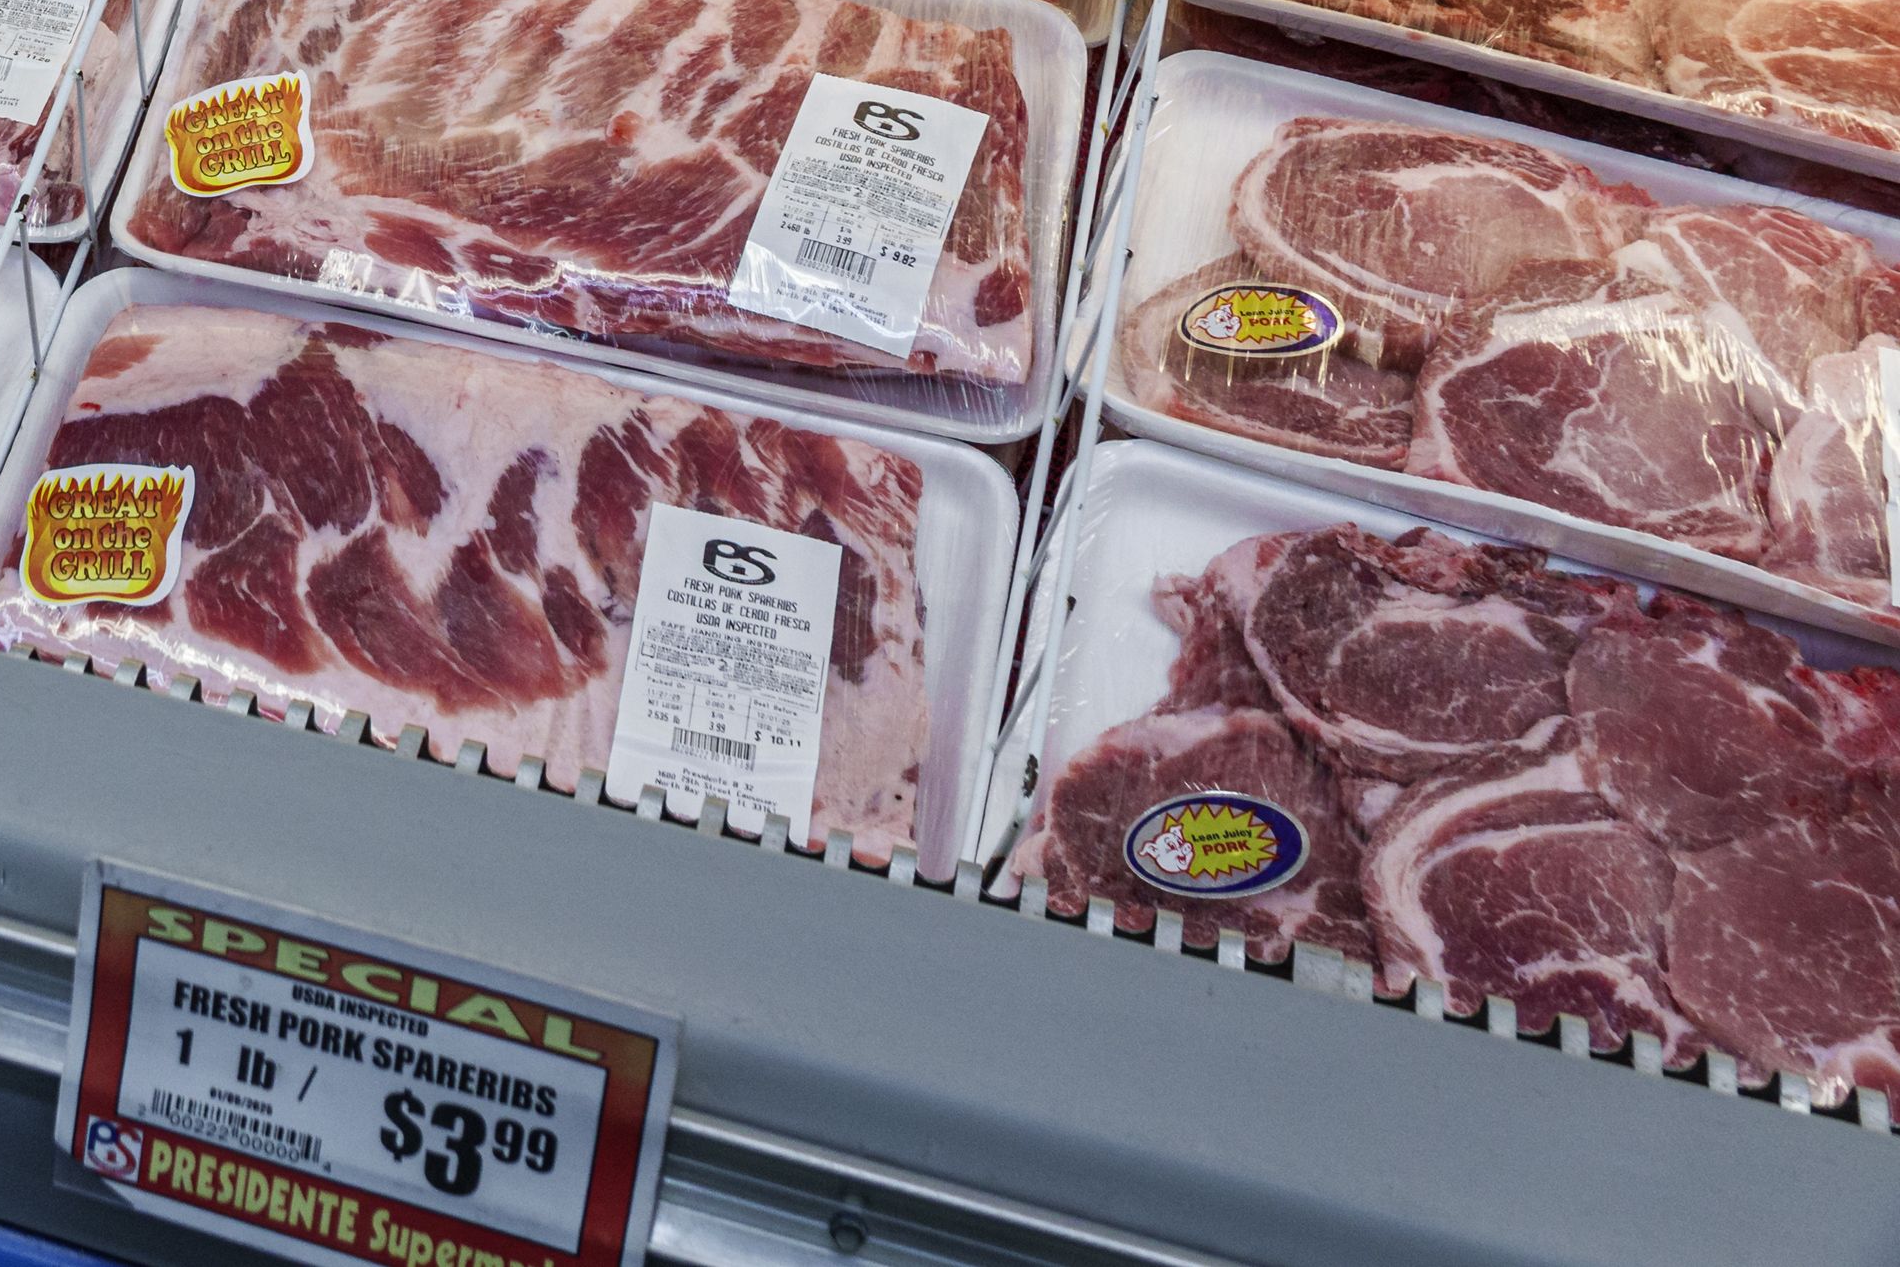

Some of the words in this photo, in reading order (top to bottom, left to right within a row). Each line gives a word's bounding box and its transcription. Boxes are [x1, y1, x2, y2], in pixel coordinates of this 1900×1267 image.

[184, 90, 284, 134] GREAT
[196, 131, 235, 154] on
[238, 118, 284, 147] the
[200, 140, 291, 178] GRILL
[48, 491, 161, 520] GREAT
[52, 527, 91, 550] on
[99, 520, 153, 549] the
[51, 548, 152, 582] GRILL
[667, 589, 717, 610] COSTILLAS
[722, 601, 735, 615] DE
[739, 605, 770, 624] CERDO
[774, 613, 811, 633] FRESCA
[683, 577, 714, 594] FRESH
[719, 585, 742, 601] PORK
[748, 591, 798, 614] SPARERIBS
[696, 612, 720, 628] USDA
[725, 619, 777, 641] INSPECTED
[1190, 830, 1222, 844] Lean
[1223, 827, 1253, 842] Juicy
[1202, 839, 1251, 858] PORK
[147, 906, 601, 1061] SPECIAL
[293, 985, 336, 1012] USDA
[339, 996, 430, 1037] INSPECTED
[174, 980, 269, 1034] FRESH
[278, 1008, 365, 1062] PORK
[372, 1040, 558, 1116] SPARERIBS
[176, 1028, 193, 1066] 1
[237, 1046, 276, 1090] lb
[149, 1139, 360, 1243] PRESIDENTE
[369, 1208, 555, 1267] Superm
